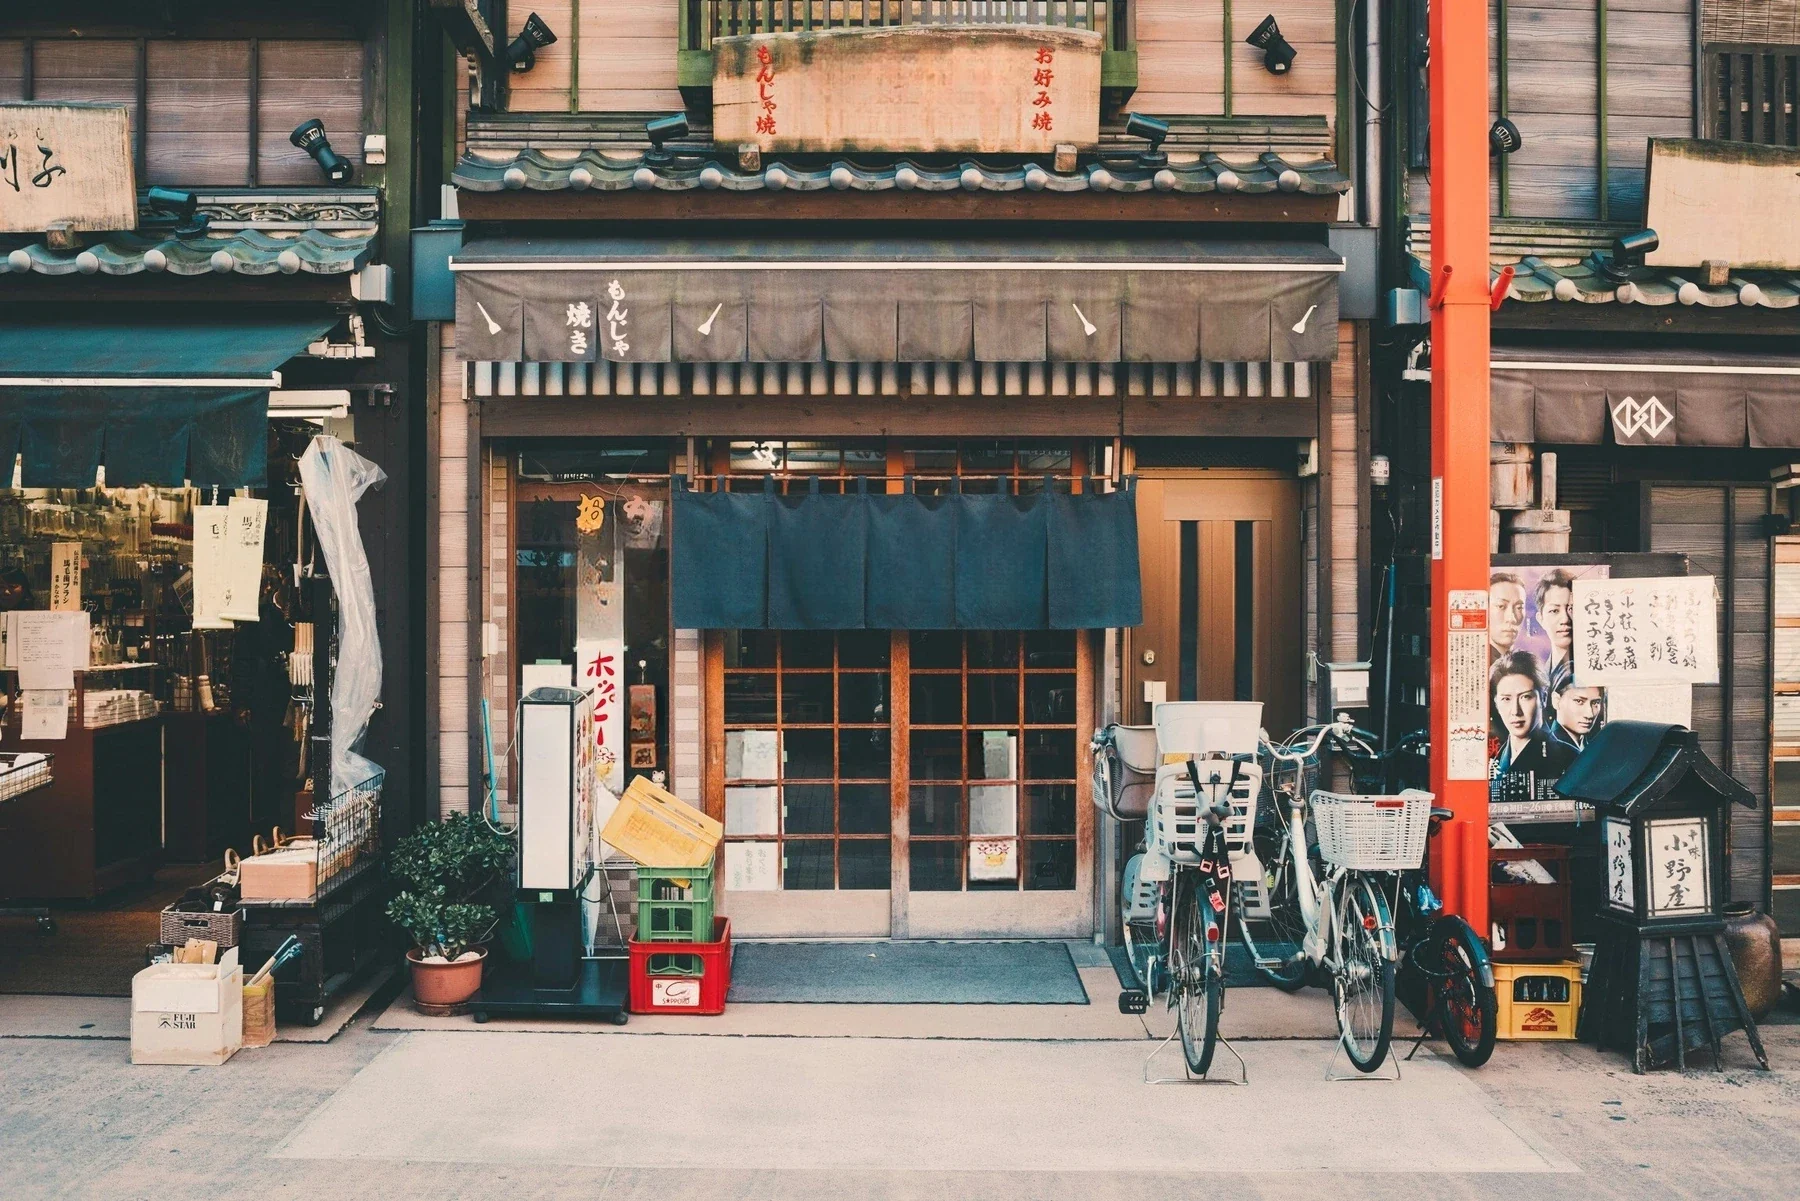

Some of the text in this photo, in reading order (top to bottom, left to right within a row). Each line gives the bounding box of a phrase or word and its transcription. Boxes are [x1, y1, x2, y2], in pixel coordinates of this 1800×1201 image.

[756, 45, 777, 135] もんじゃ焼
[1032, 46, 1055, 131] お好み焼
[566, 301, 592, 355] 焼き
[606, 279, 630, 357] もんじゃ
[586, 650, 616, 746] ホッピー
[1613, 831, 1627, 902] 小野屋
[1664, 834, 1692, 909] 小野屋
[173, 1014, 196, 1022] FUJI
